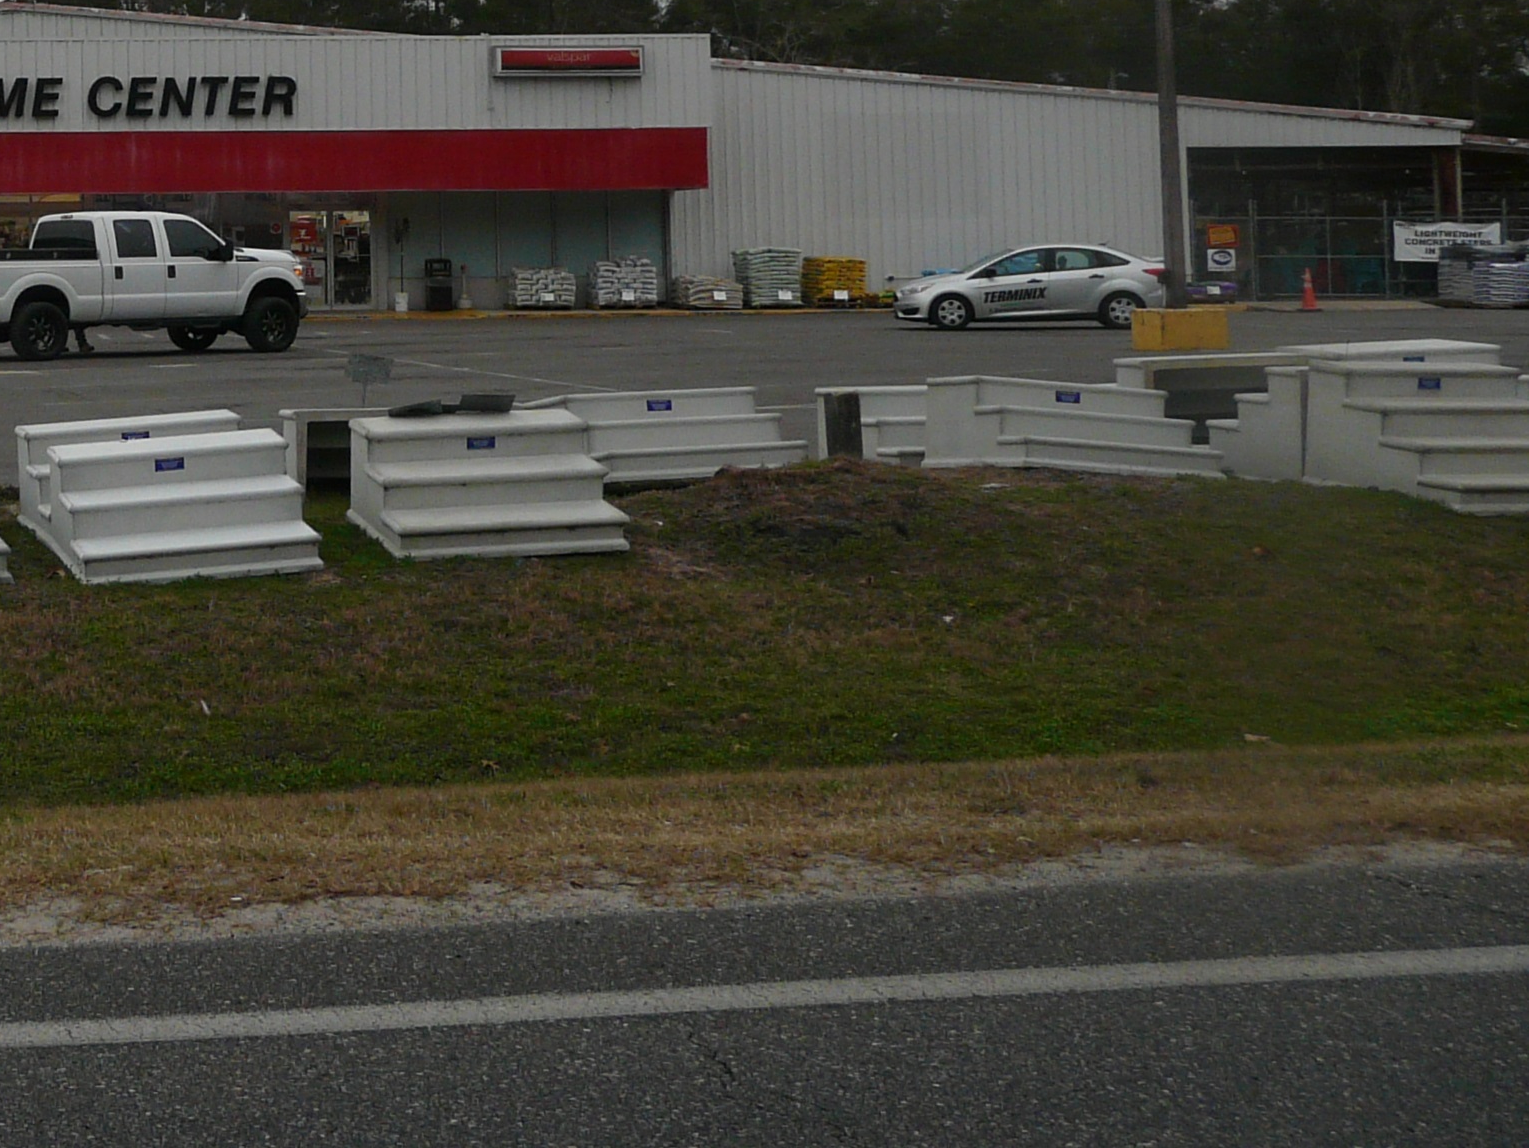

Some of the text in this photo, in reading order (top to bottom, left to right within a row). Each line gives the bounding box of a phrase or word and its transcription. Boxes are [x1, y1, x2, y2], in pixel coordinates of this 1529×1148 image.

[87, 75, 298, 118] CENTER
[1414, 230, 1484, 239] LIGHTWEIGHT
[1404, 238, 1457, 247] CONCRETE
[983, 287, 1048, 304] TERMINIX
